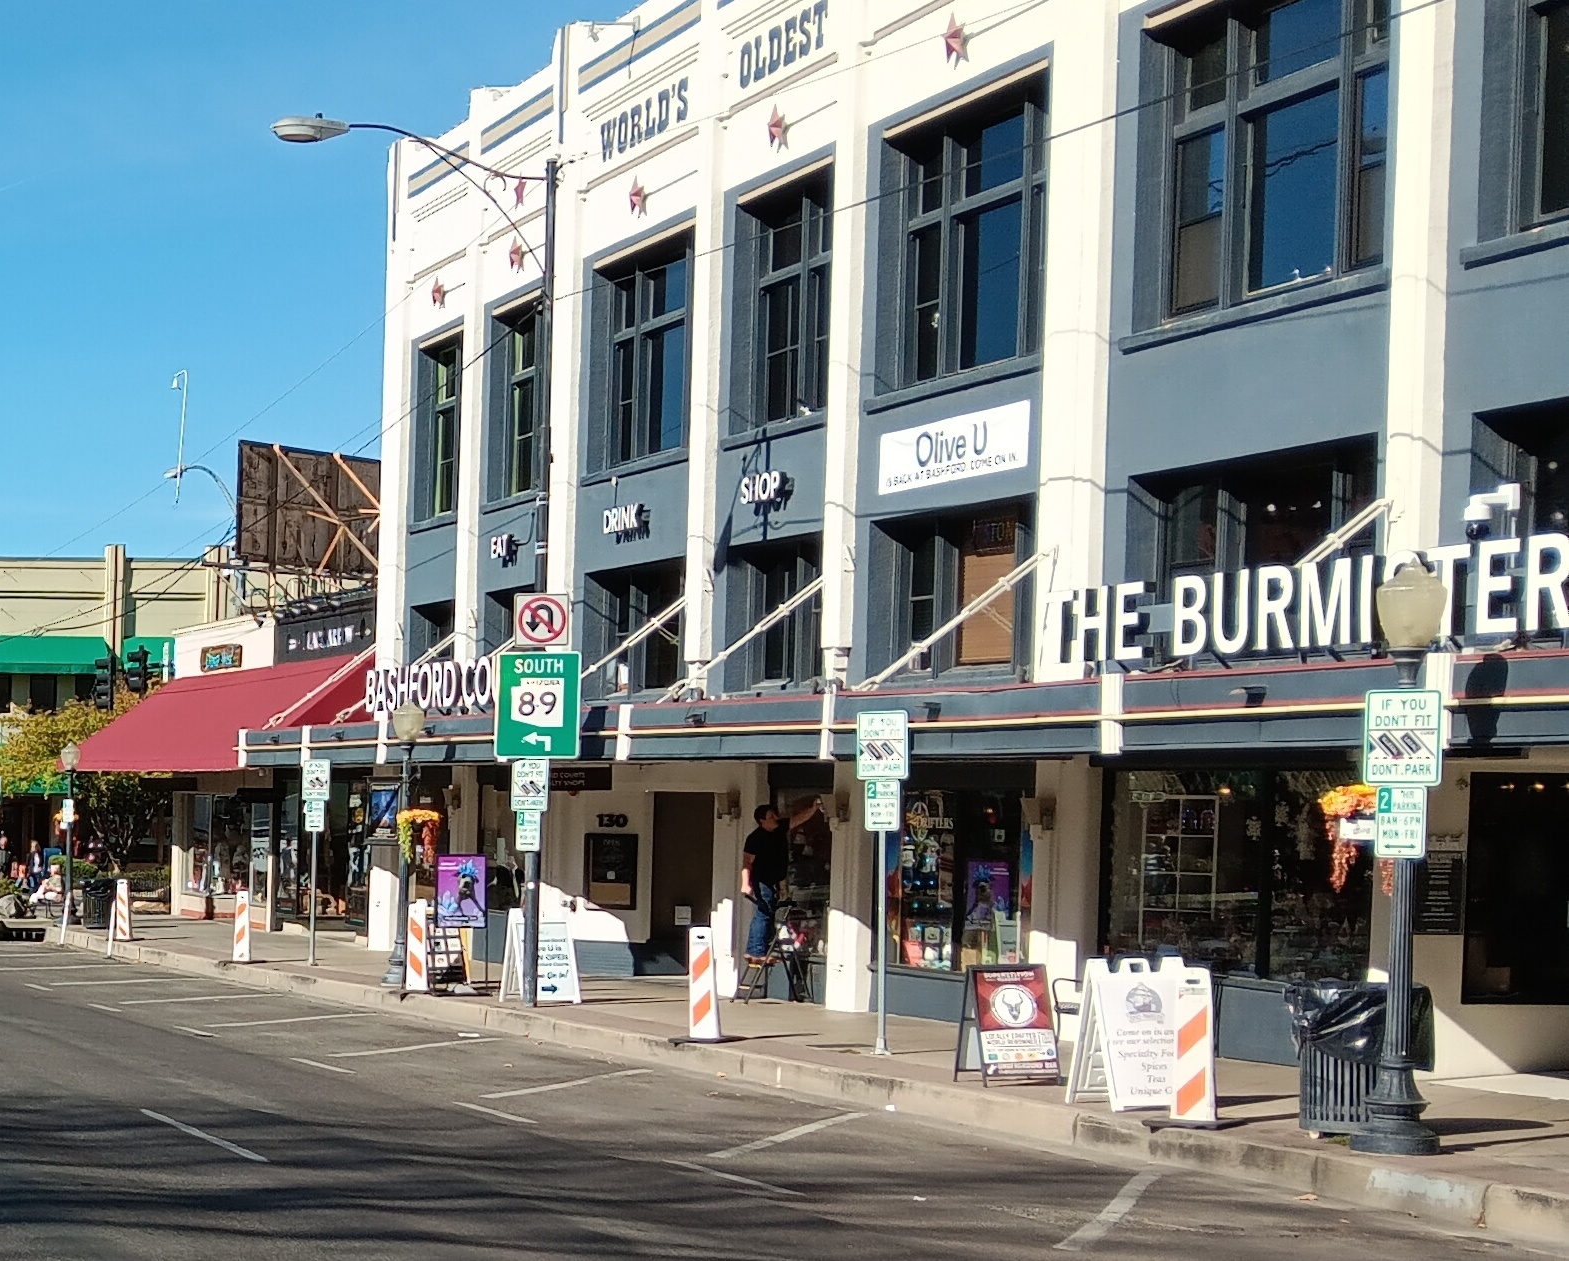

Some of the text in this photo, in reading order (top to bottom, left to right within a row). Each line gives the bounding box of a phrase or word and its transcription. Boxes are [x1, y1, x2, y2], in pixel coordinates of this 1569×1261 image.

[600, 0, 829, 163] WORLD'S OLDEST
[916, 421, 988, 468] Olive U
[893, 472, 913, 486] BACK
[971, 456, 992, 471] COME
[994, 454, 1006, 466] ON
[740, 470, 781, 505] SHOP
[603, 502, 640, 534] DRINK
[490, 533, 509, 560] EAT
[1042, 532, 1569, 665] THE BURMITER
[513, 658, 564, 674] SOUTH
[365, 655, 498, 713] BASHFORD CO
[518, 691, 557, 717] 89
[1381, 698, 1427, 711] IF YOU
[867, 718, 897, 727] IF YOU
[1375, 714, 1433, 727] DON'T FIT
[889, 729, 901, 737] FIT
[882, 763, 902, 772] PARK
[1404, 763, 1432, 776] PARK
[867, 783, 876, 797] 2
[1379, 791, 1415, 809] 2 HR
[1392, 802, 1422, 811] PARKING
[596, 813, 629, 828] 130
[915, 817, 954, 830] DRIFTERS
[1116, 1028, 1140, 1037] Come
[1153, 1028, 1162, 1036] in
[1118, 1050, 1158, 1061] Specialty
[1141, 1063, 1168, 1072] Spices
[1146, 1074, 1166, 1083] Teas
[1130, 1086, 1163, 1097] Unique
